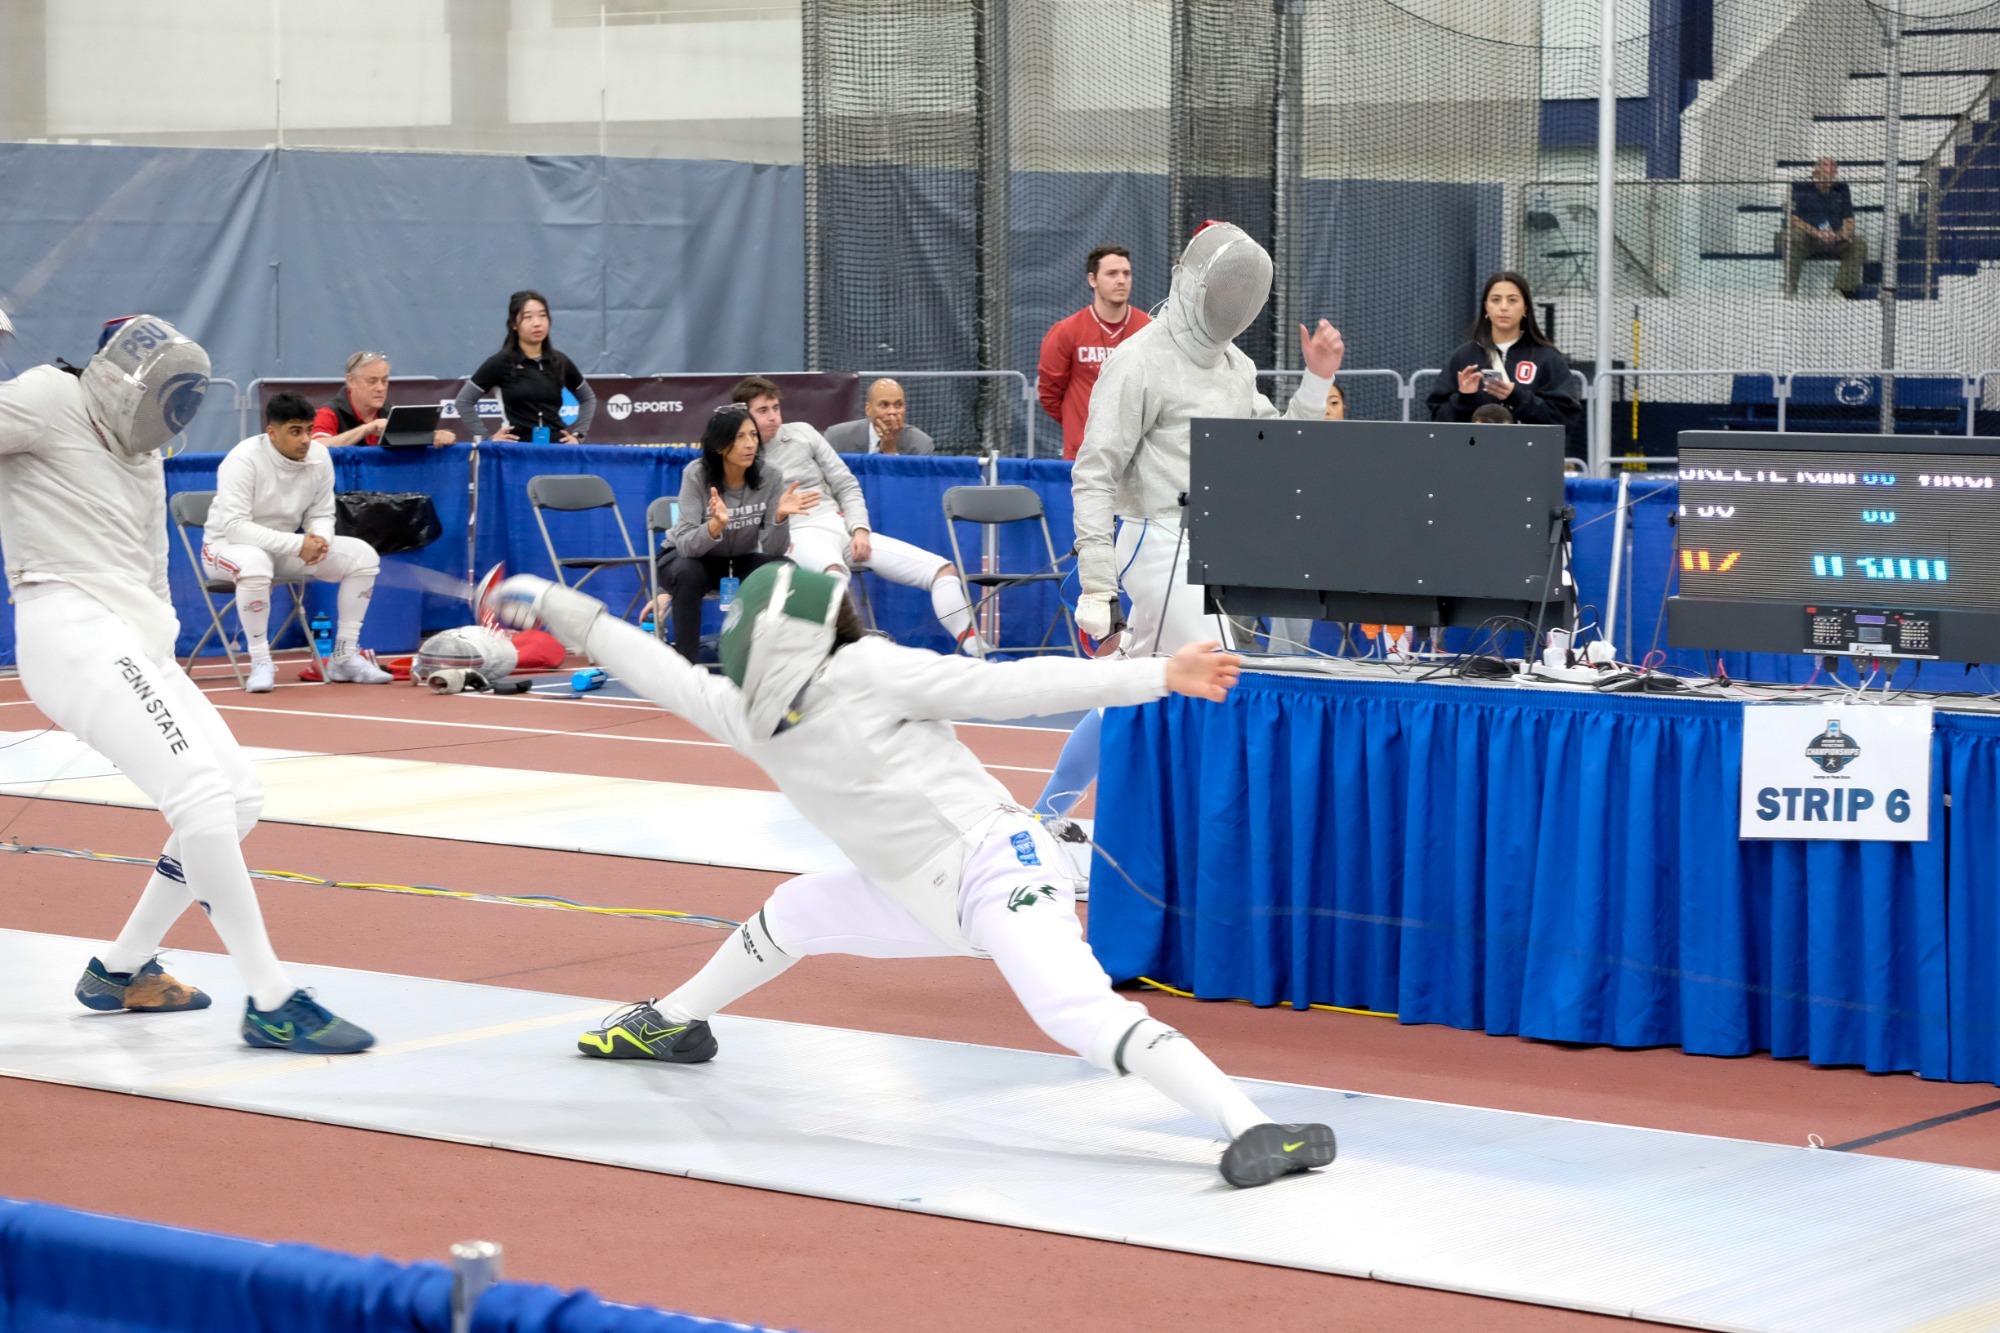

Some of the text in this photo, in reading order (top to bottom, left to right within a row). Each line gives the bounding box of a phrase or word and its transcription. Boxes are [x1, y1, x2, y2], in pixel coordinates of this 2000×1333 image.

[122, 322, 168, 361] PSU
[1515, 361, 1538, 384] O
[633, 401, 684, 413] SPORTS
[705, 502, 767, 516] CUMBIA
[114, 657, 189, 755] PENN STATE
[1756, 786, 1911, 823] STRIP 6
